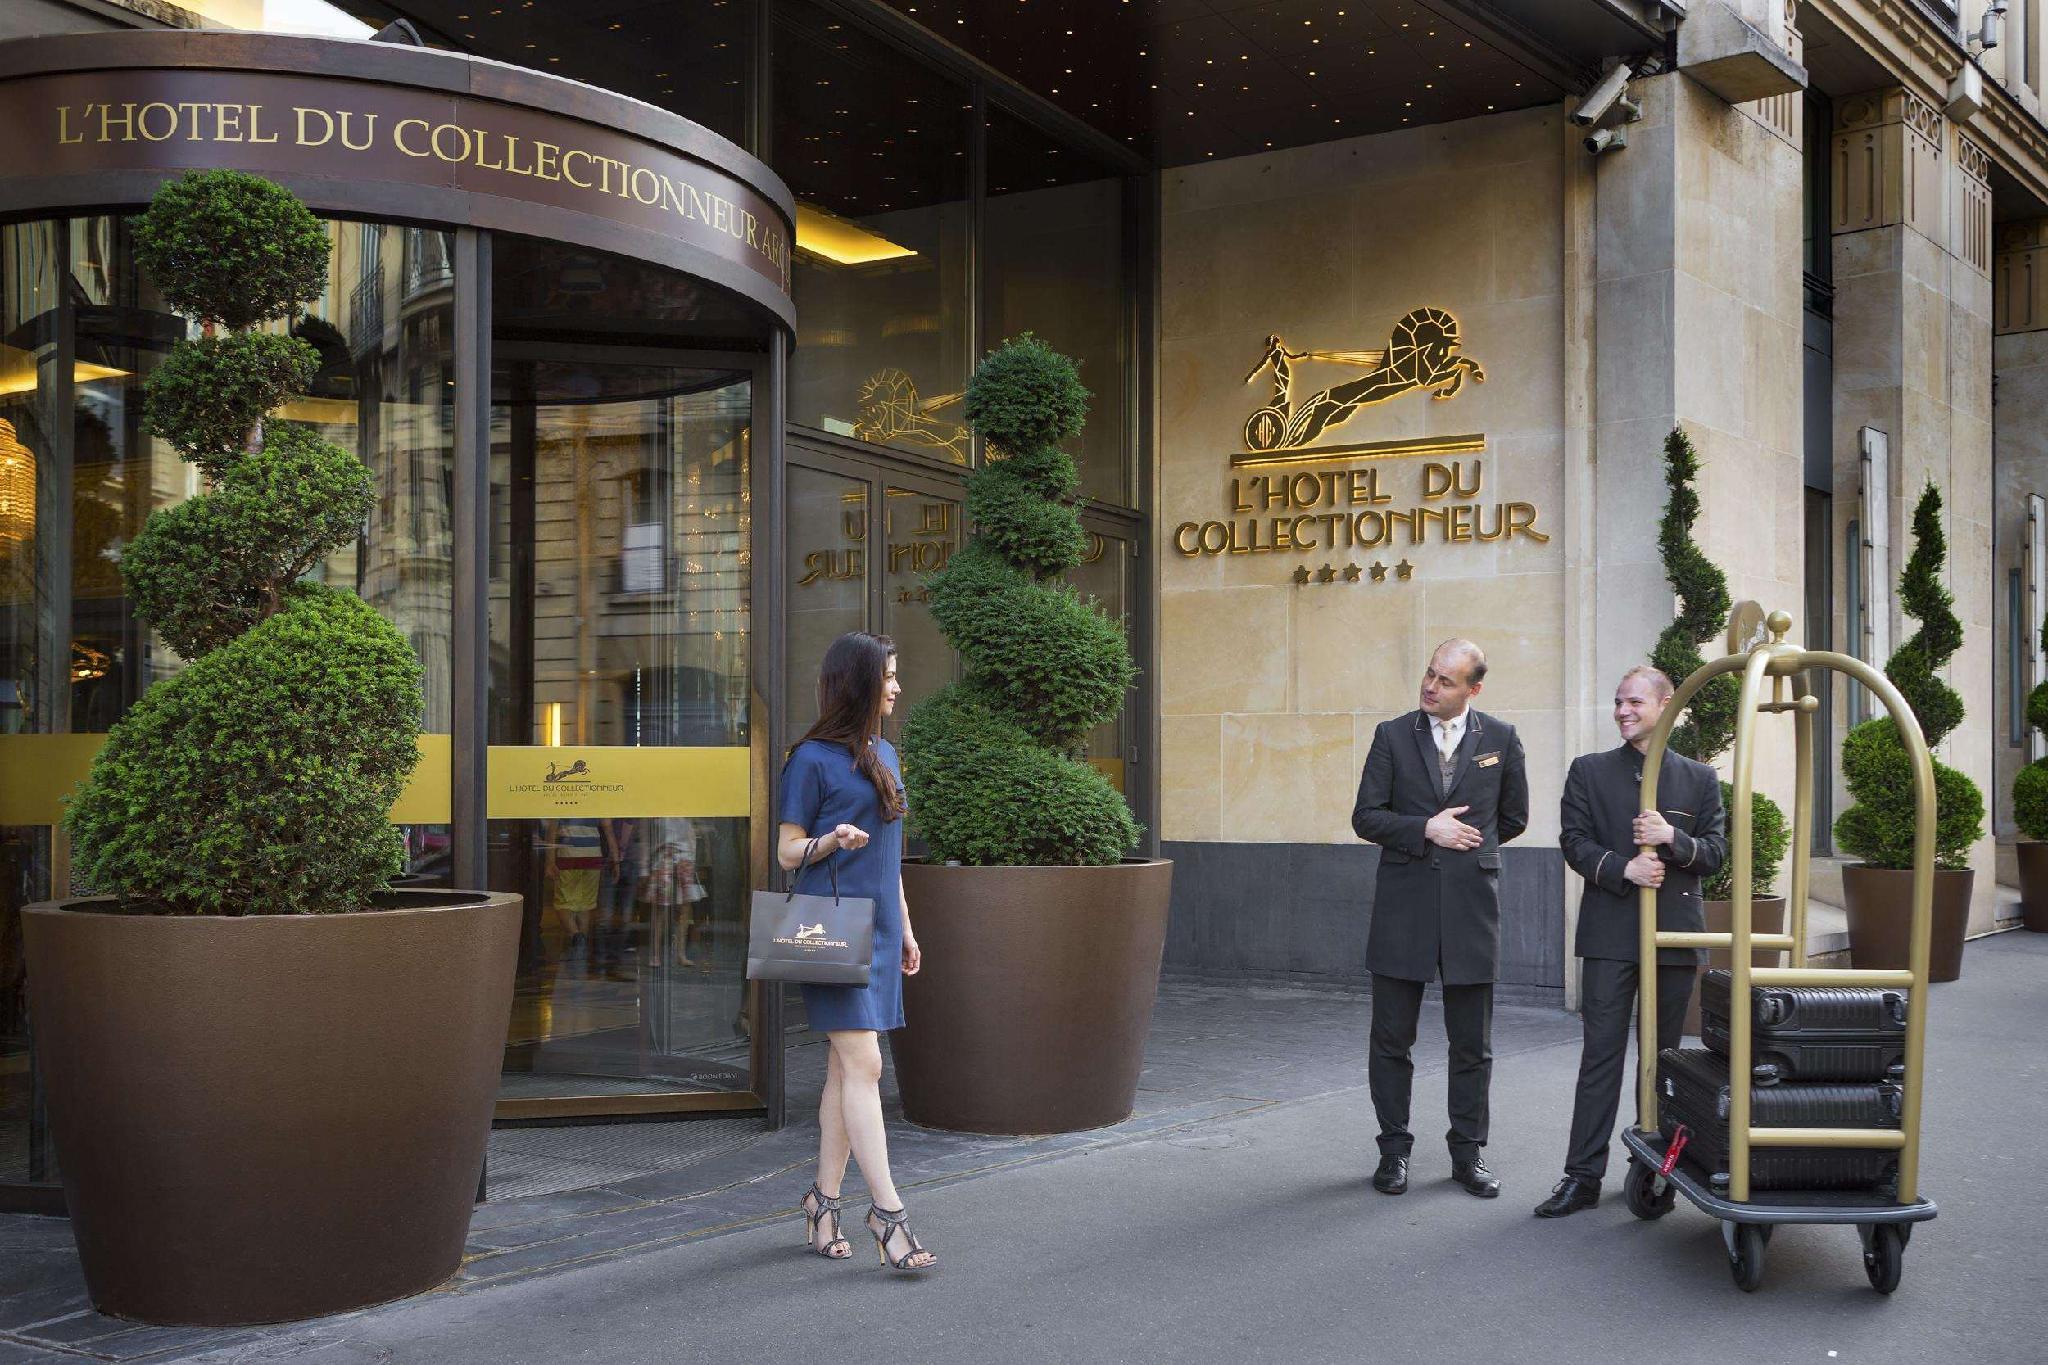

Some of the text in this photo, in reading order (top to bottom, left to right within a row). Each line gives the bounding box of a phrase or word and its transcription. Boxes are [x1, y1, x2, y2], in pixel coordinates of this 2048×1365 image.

[57, 102, 278, 144] L'HOTEL
[292, 107, 378, 151] DU
[393, 119, 759, 250] COLLECTIONNEUR
[1232, 460, 1482, 512] L'HOTEL DU
[1174, 502, 1551, 557] COLLECTIONNEUR
